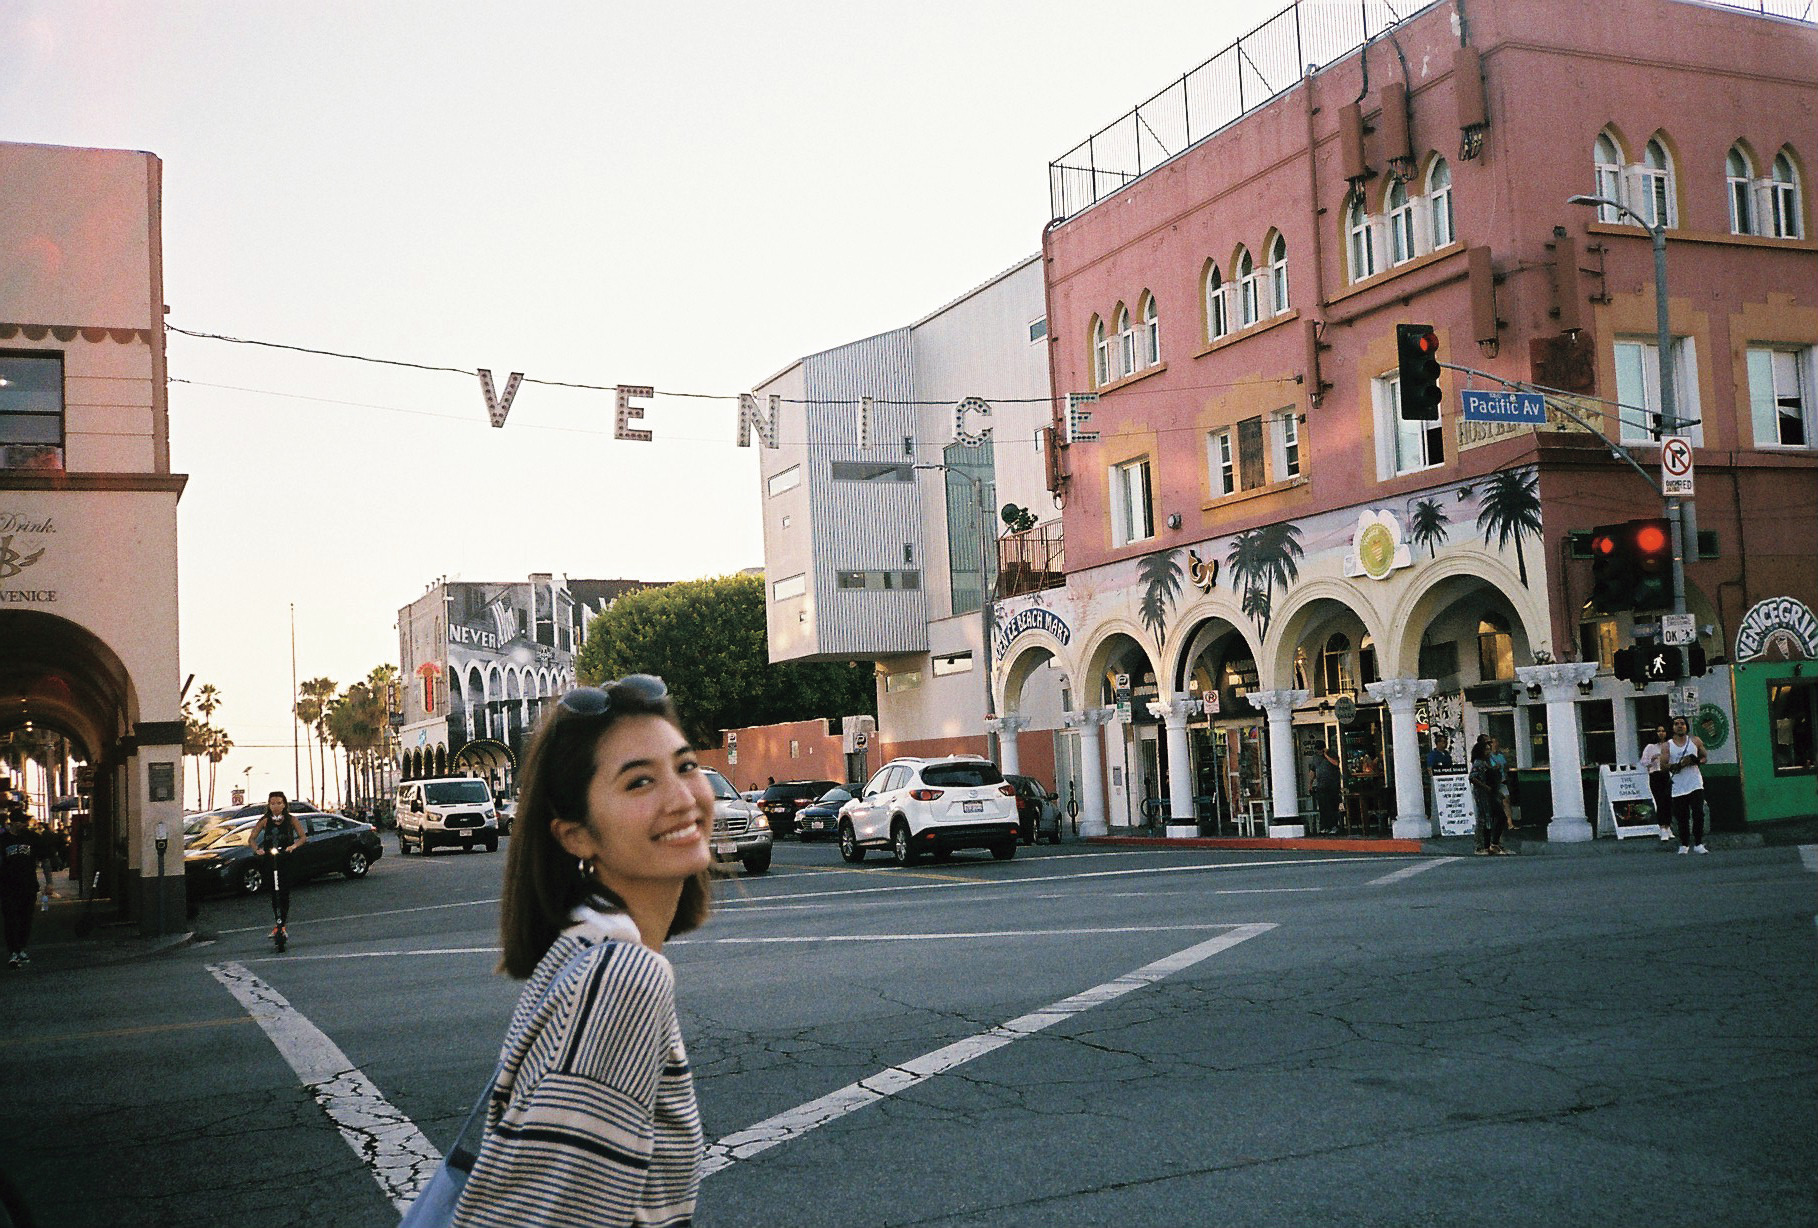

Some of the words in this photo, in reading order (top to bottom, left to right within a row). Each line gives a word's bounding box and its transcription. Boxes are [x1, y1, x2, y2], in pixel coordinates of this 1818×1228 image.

[477, 368, 1100, 448] VENICE
[1469, 397, 1519, 415] Pacific
[1523, 399, 1539, 415] Av
[0, 590, 57, 602] VENICE
[450, 623, 497, 649] NEVER
[1016, 610, 1043, 632] BEACH
[1045, 613, 1069, 644] MART
[1665, 630, 1678, 642] OK
[1740, 603, 1780, 657] VENICE
